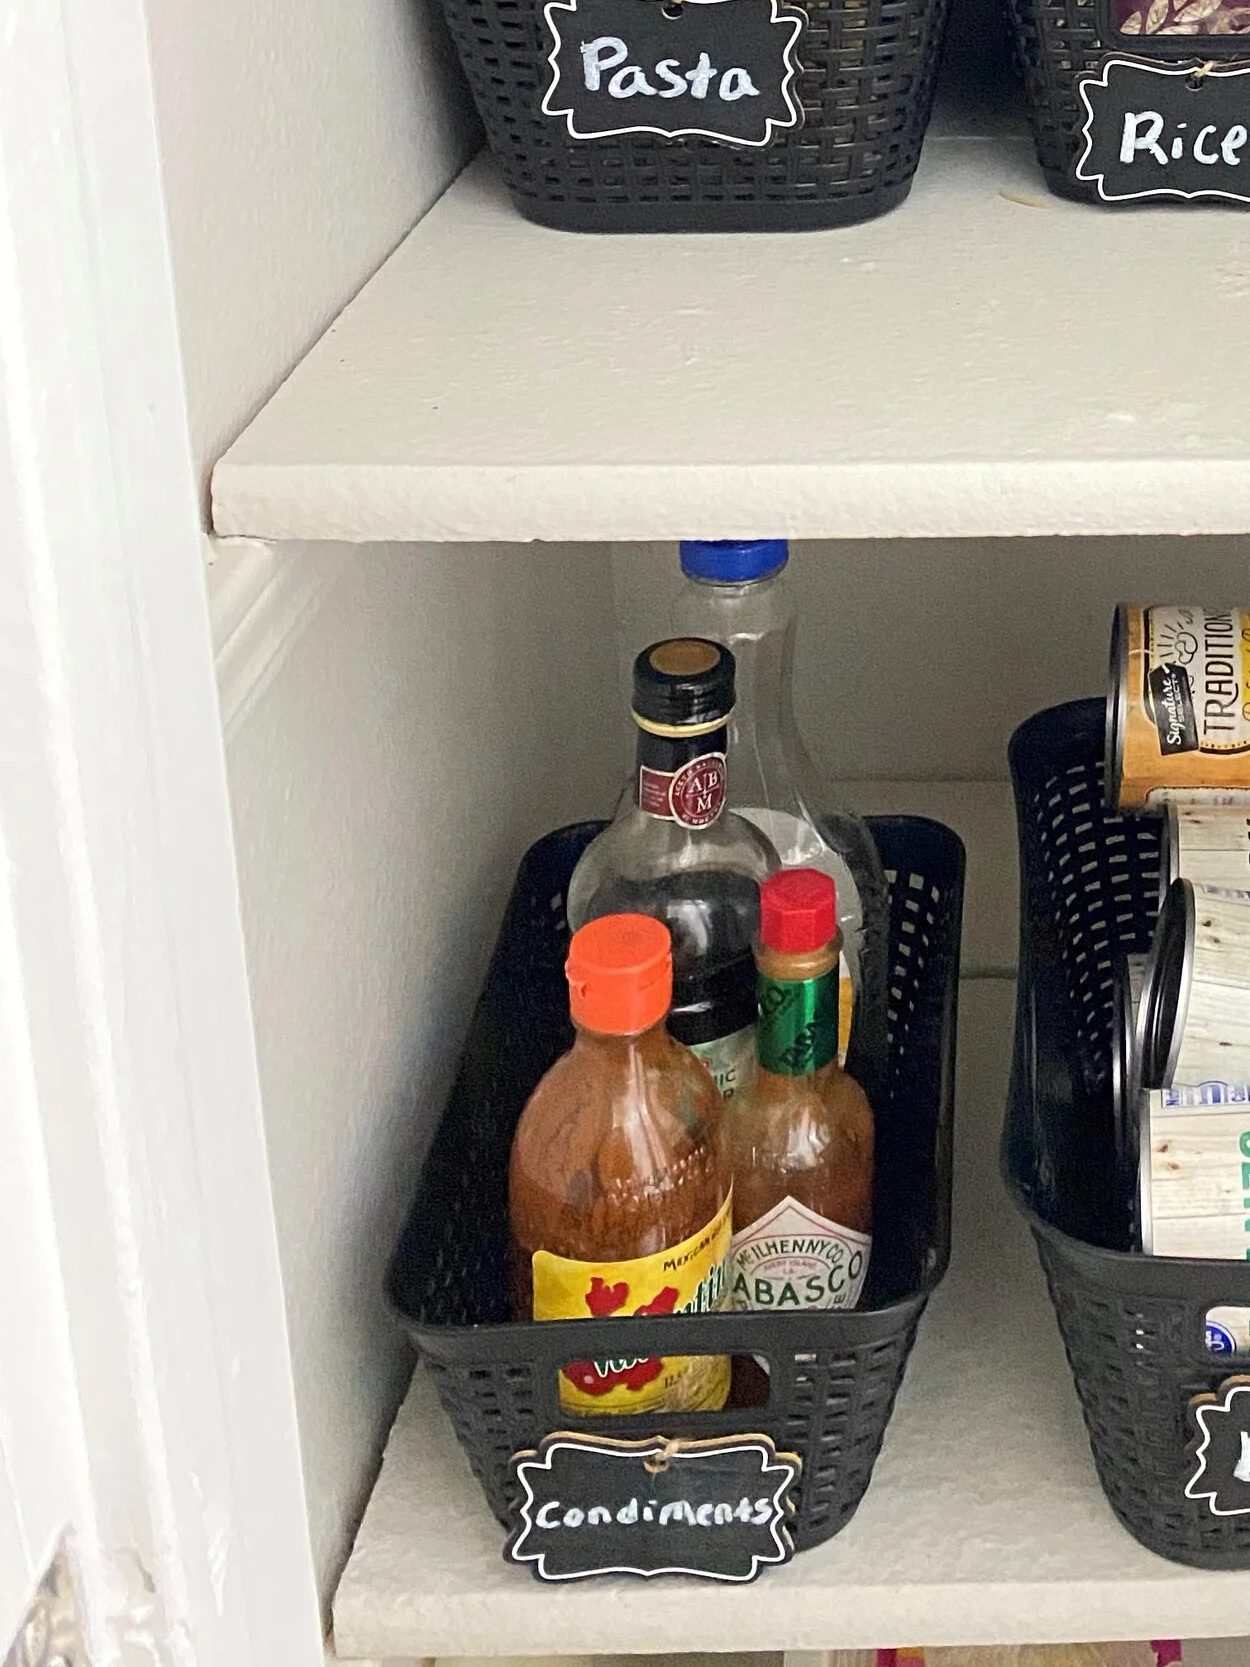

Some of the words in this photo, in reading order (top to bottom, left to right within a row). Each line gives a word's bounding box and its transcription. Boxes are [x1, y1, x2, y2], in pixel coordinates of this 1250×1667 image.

[580, 36, 761, 101] Pasta
[1119, 110, 1248, 166] Rice
[1161, 676, 1186, 745] Signature
[1172, 679, 1185, 723] SELECT
[688, 777, 703, 793] A
[708, 771, 718, 788] B
[696, 794, 713, 814] M
[733, 1249, 863, 1307] ABASCO
